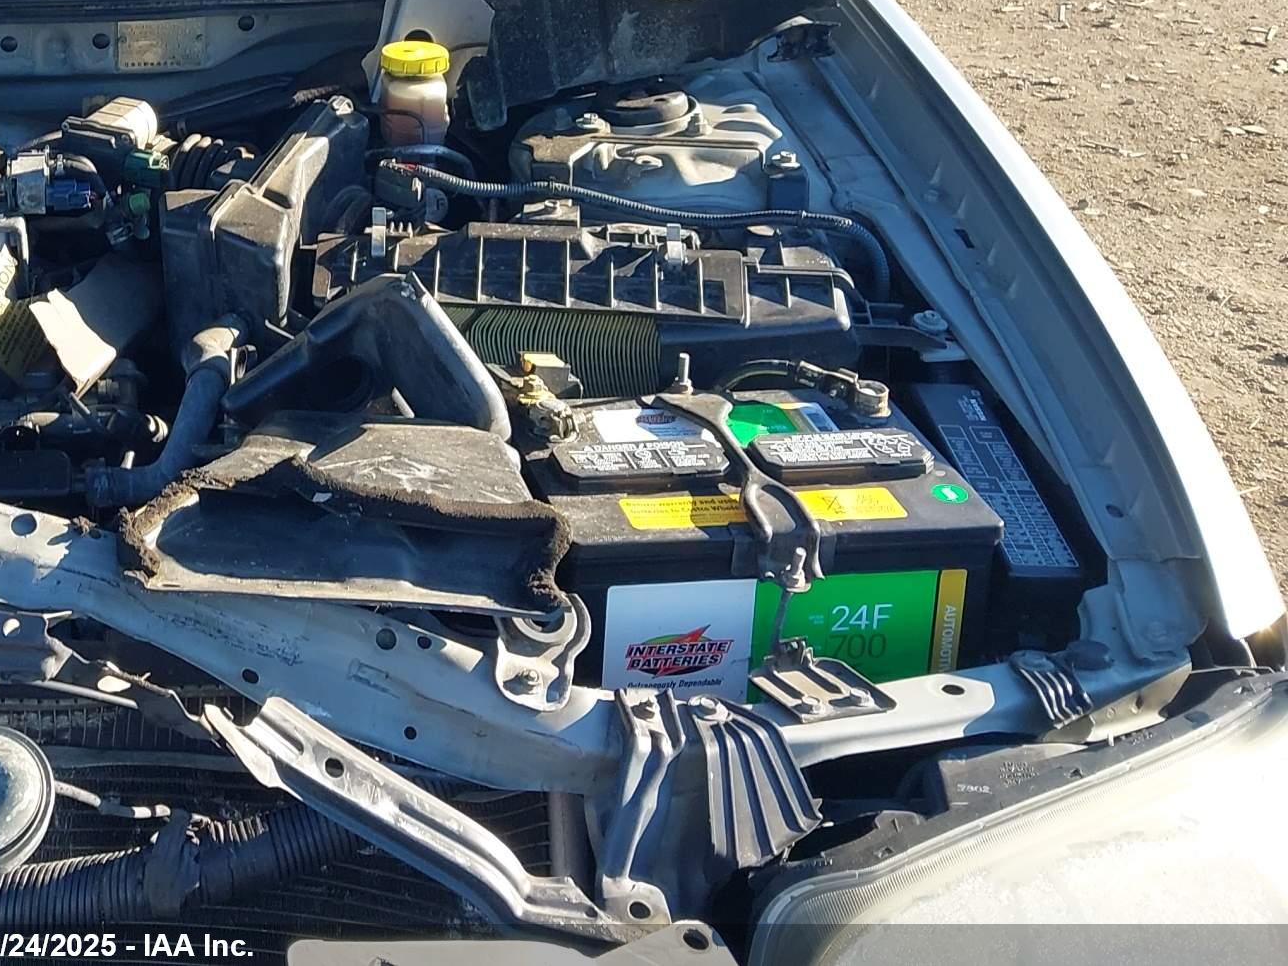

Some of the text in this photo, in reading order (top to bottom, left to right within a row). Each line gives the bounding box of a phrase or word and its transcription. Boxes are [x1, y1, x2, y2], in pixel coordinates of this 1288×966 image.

[830, 603, 894, 632] 24F
[626, 640, 733, 658] INTERSTATE
[829, 632, 887, 660] 700
[627, 654, 723, 670] BATTERIES
[678, 677, 723, 688] Dependable
